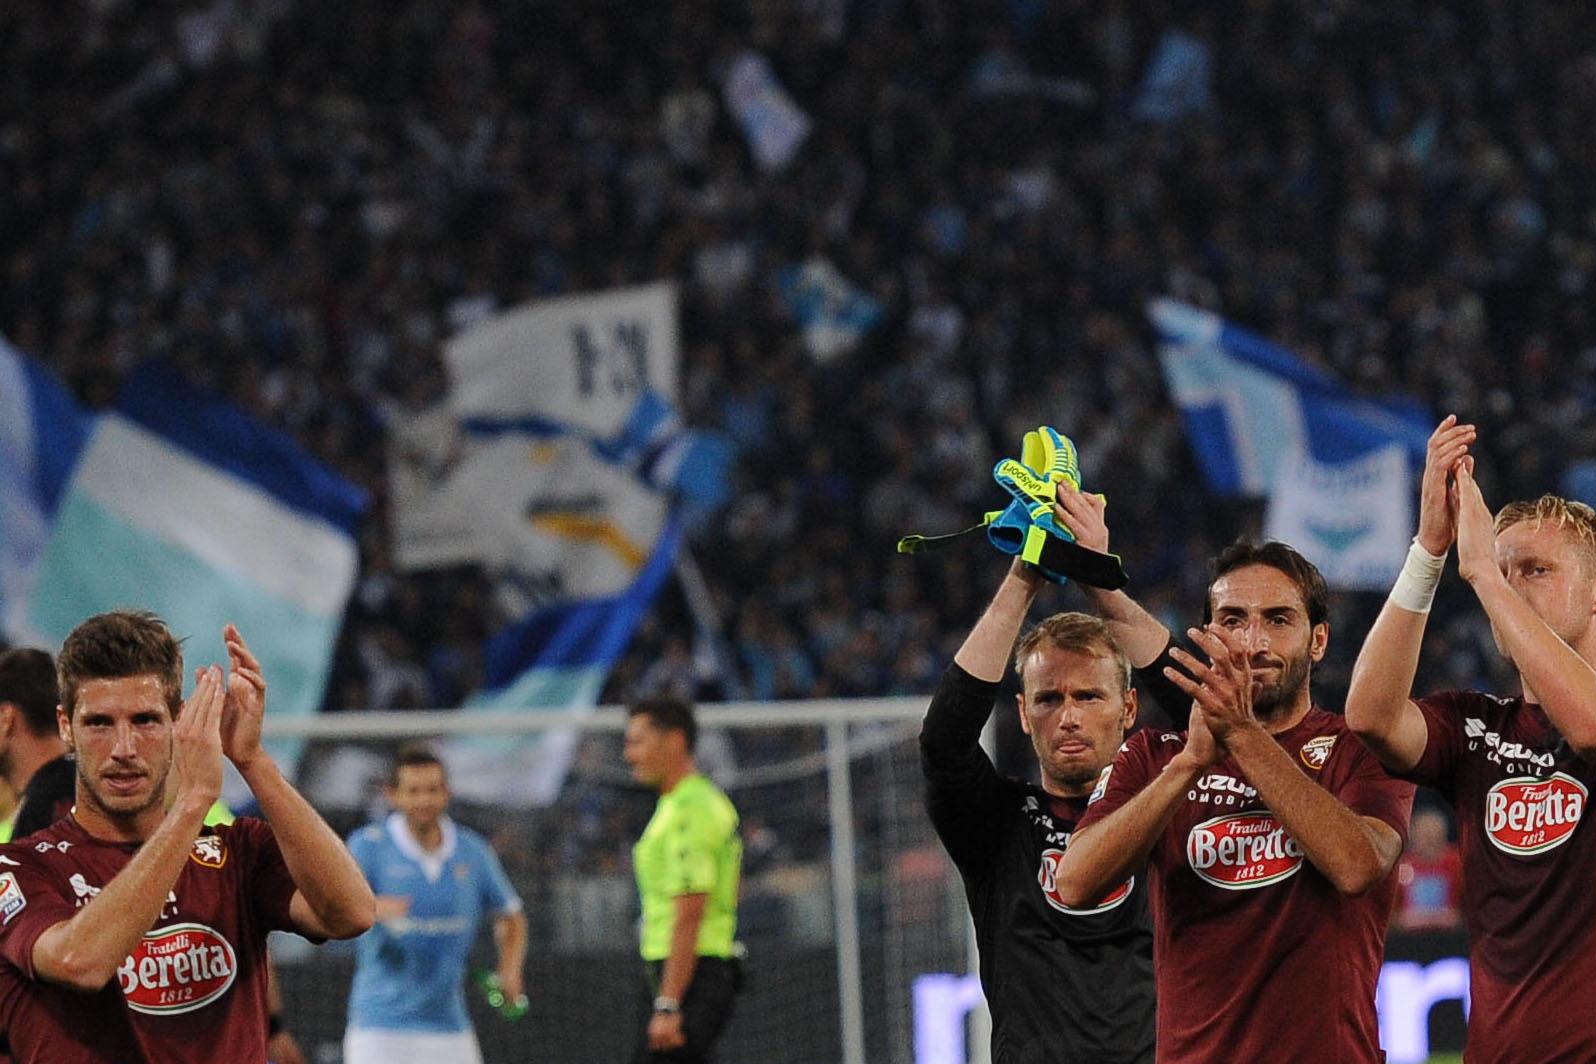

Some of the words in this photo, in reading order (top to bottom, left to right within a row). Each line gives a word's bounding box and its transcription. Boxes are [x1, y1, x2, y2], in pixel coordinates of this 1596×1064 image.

[1226, 819, 1272, 835] Fratelli
[1194, 825, 1305, 869] Beretta
[1234, 864, 1265, 881] 1812
[143, 934, 190, 956] Fratelli
[160, 986, 193, 1004] 1812
